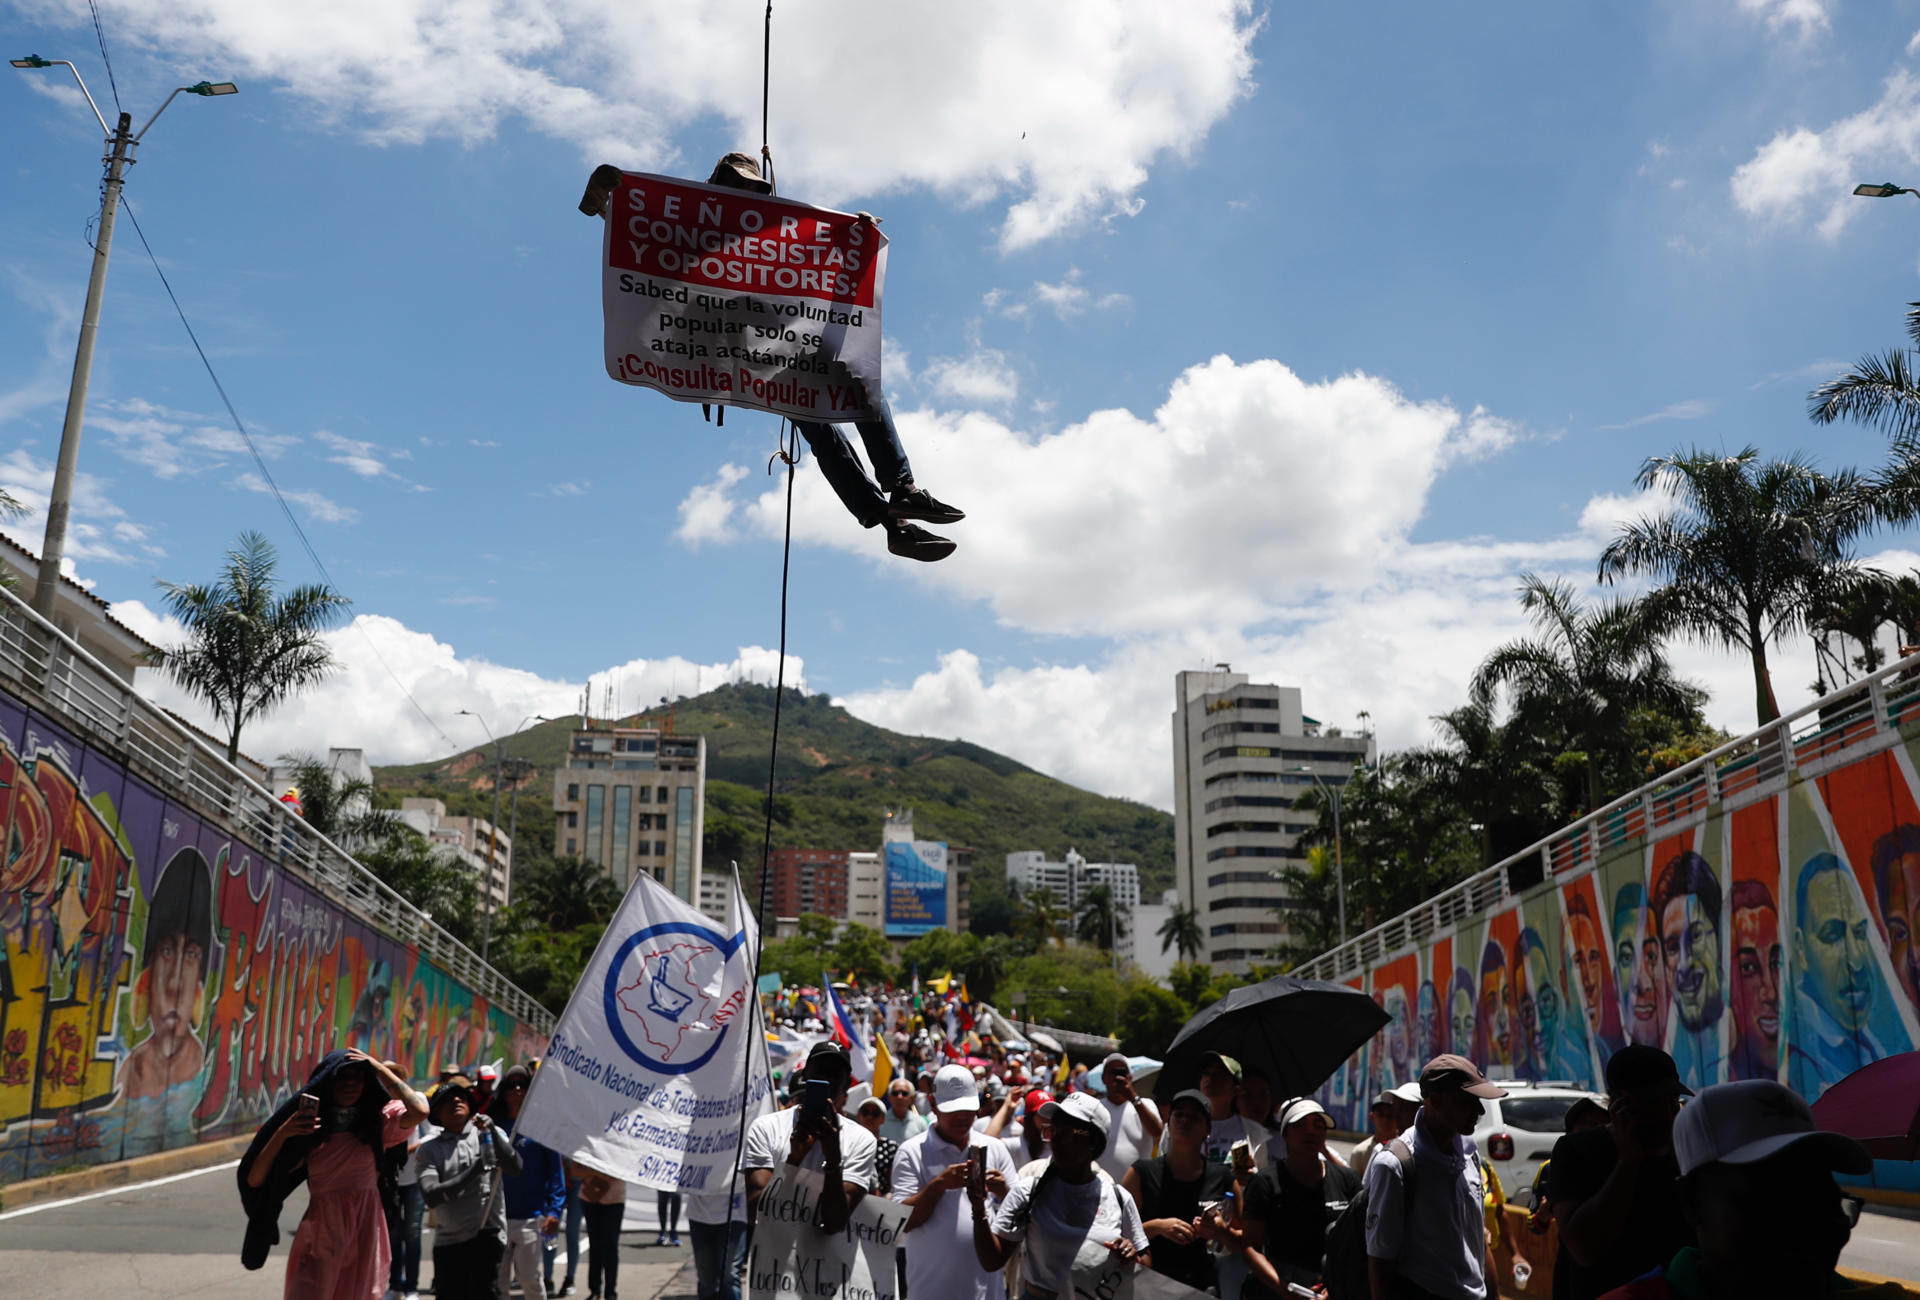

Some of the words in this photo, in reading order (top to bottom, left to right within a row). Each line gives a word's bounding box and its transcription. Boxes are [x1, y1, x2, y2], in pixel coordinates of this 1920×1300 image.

[628, 215, 861, 272] CONGRESISTAS
[628, 240, 650, 265] Y
[658, 249, 858, 297] OPOSITORES:
[619, 274, 689, 305] Sabed
[696, 292, 738, 313] que
[746, 296, 766, 314] la
[772, 300, 863, 328] voluntad
[651, 337, 708, 360] ataja
[716, 344, 829, 375] acatándola
[659, 312, 747, 335] popular
[755, 319, 796, 343] solo
[802, 332, 823, 348] se
[617, 353, 732, 392] ¡Consulta
[740, 368, 819, 408] Popular
[548, 1033, 601, 1081] Sindicato
[601, 1066, 653, 1103] Nacional
[652, 1087, 668, 1109] de
[795, 1254, 810, 1294] X
[813, 1257, 837, 1298] Tus
